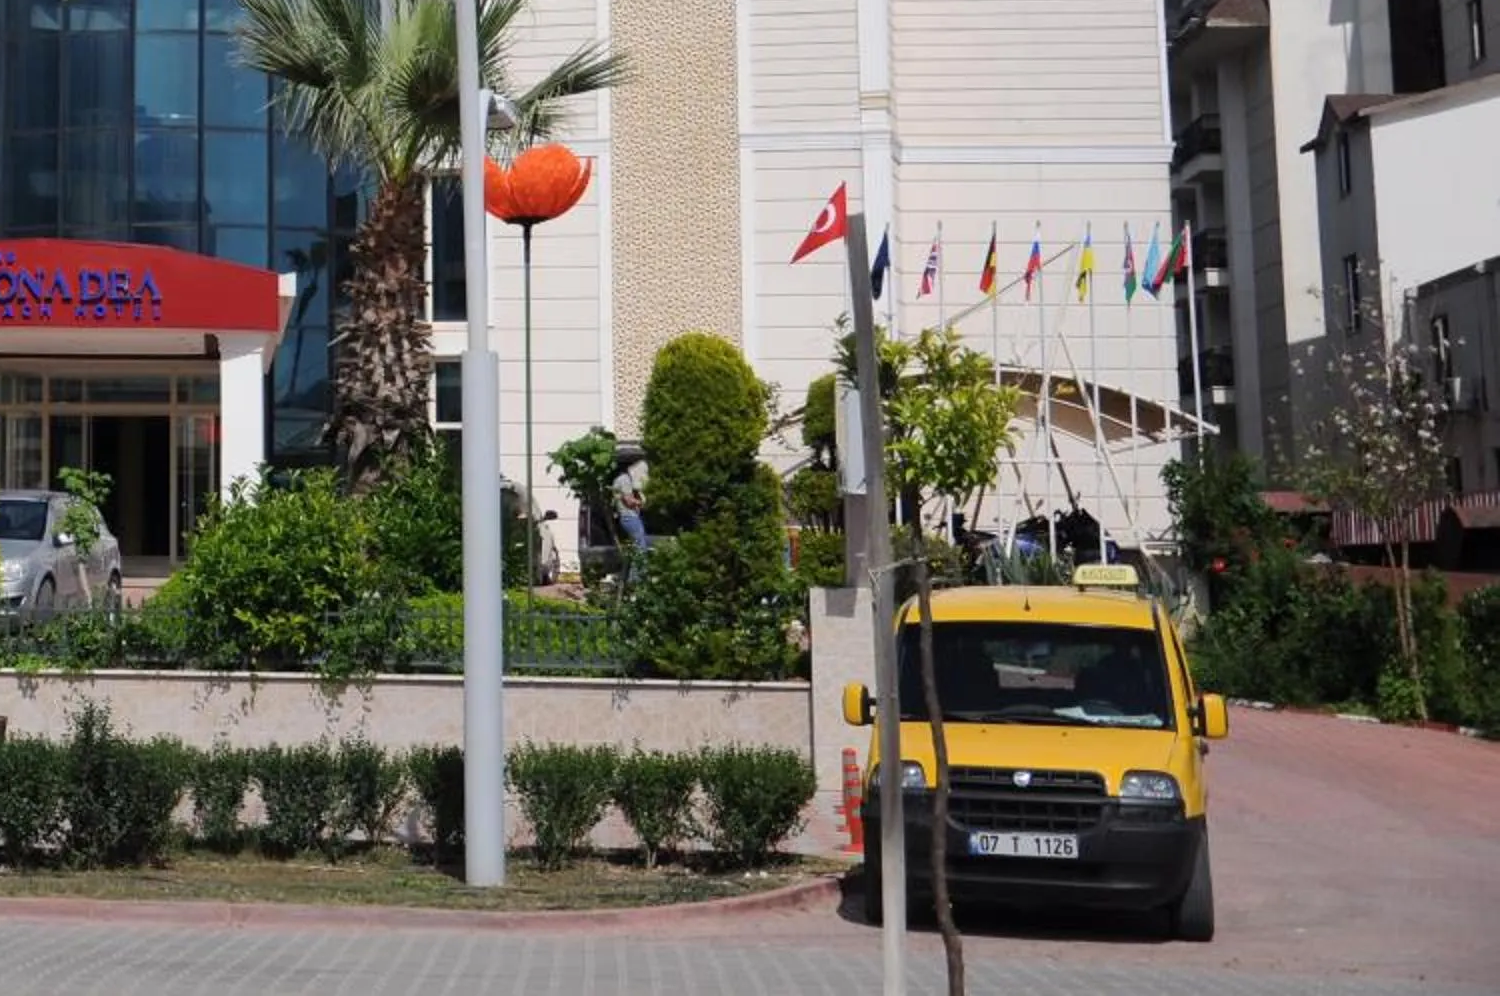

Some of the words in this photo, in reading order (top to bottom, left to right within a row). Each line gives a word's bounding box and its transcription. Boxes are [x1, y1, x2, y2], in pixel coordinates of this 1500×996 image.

[74, 303, 162, 320] HOTEL
[979, 834, 999, 852] 07
[1011, 835, 1020, 853] T
[1034, 837, 1073, 856] 1126
